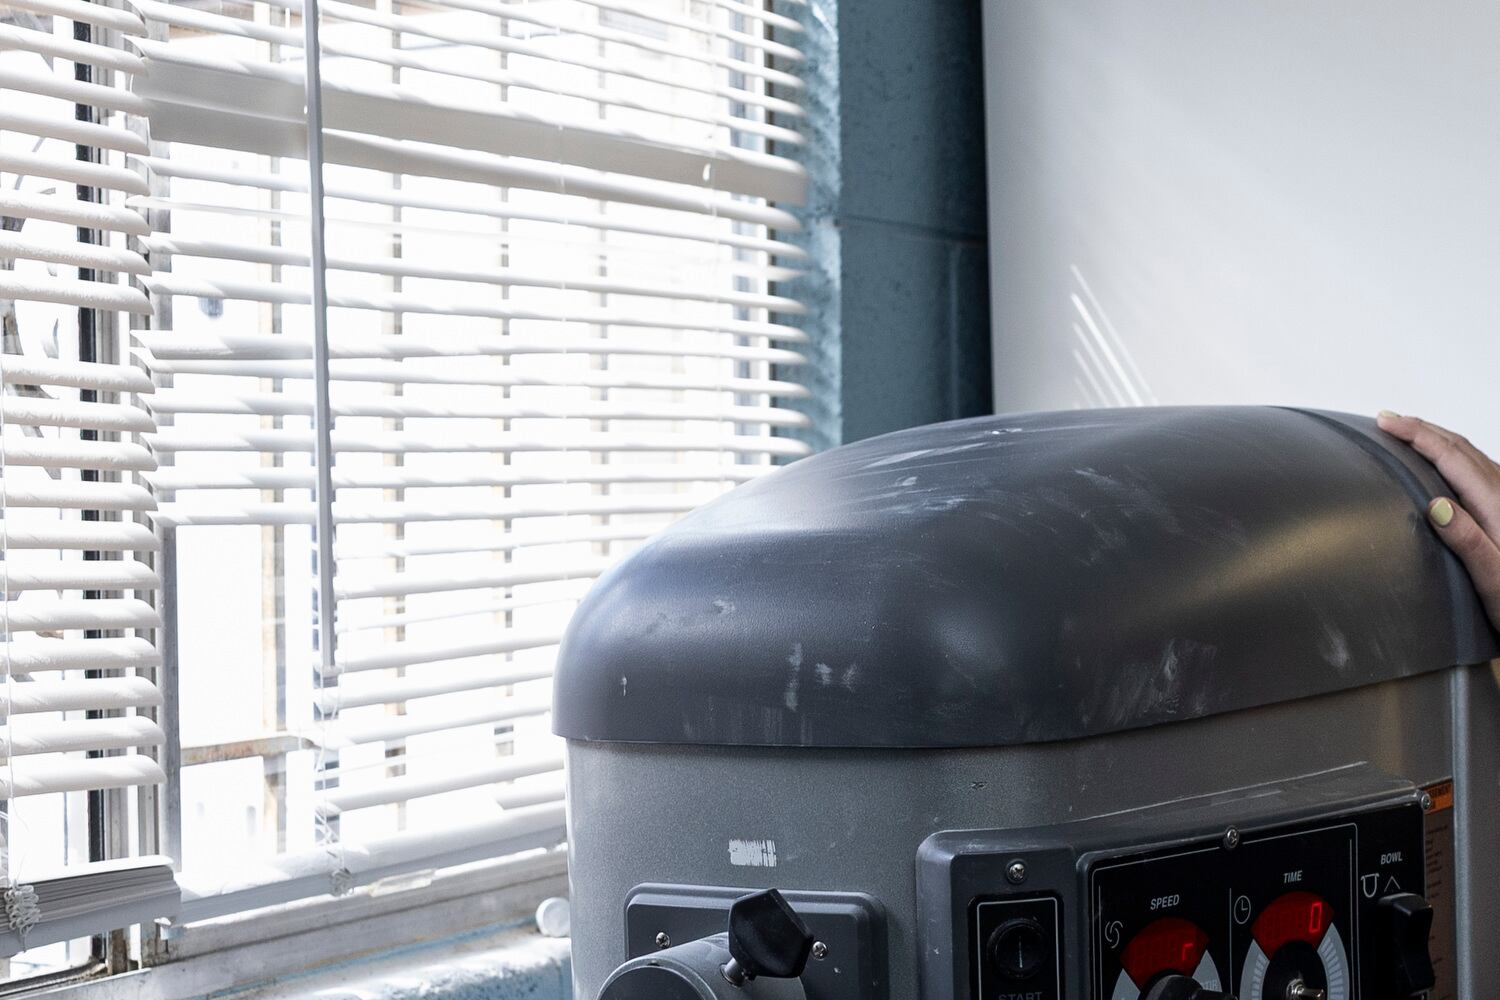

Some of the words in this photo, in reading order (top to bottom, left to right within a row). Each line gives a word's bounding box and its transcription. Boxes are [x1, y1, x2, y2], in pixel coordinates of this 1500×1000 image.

[1380, 851, 1403, 865] BOWL
[1283, 870, 1303, 884] TIME
[1150, 894, 1180, 910] SPEED
